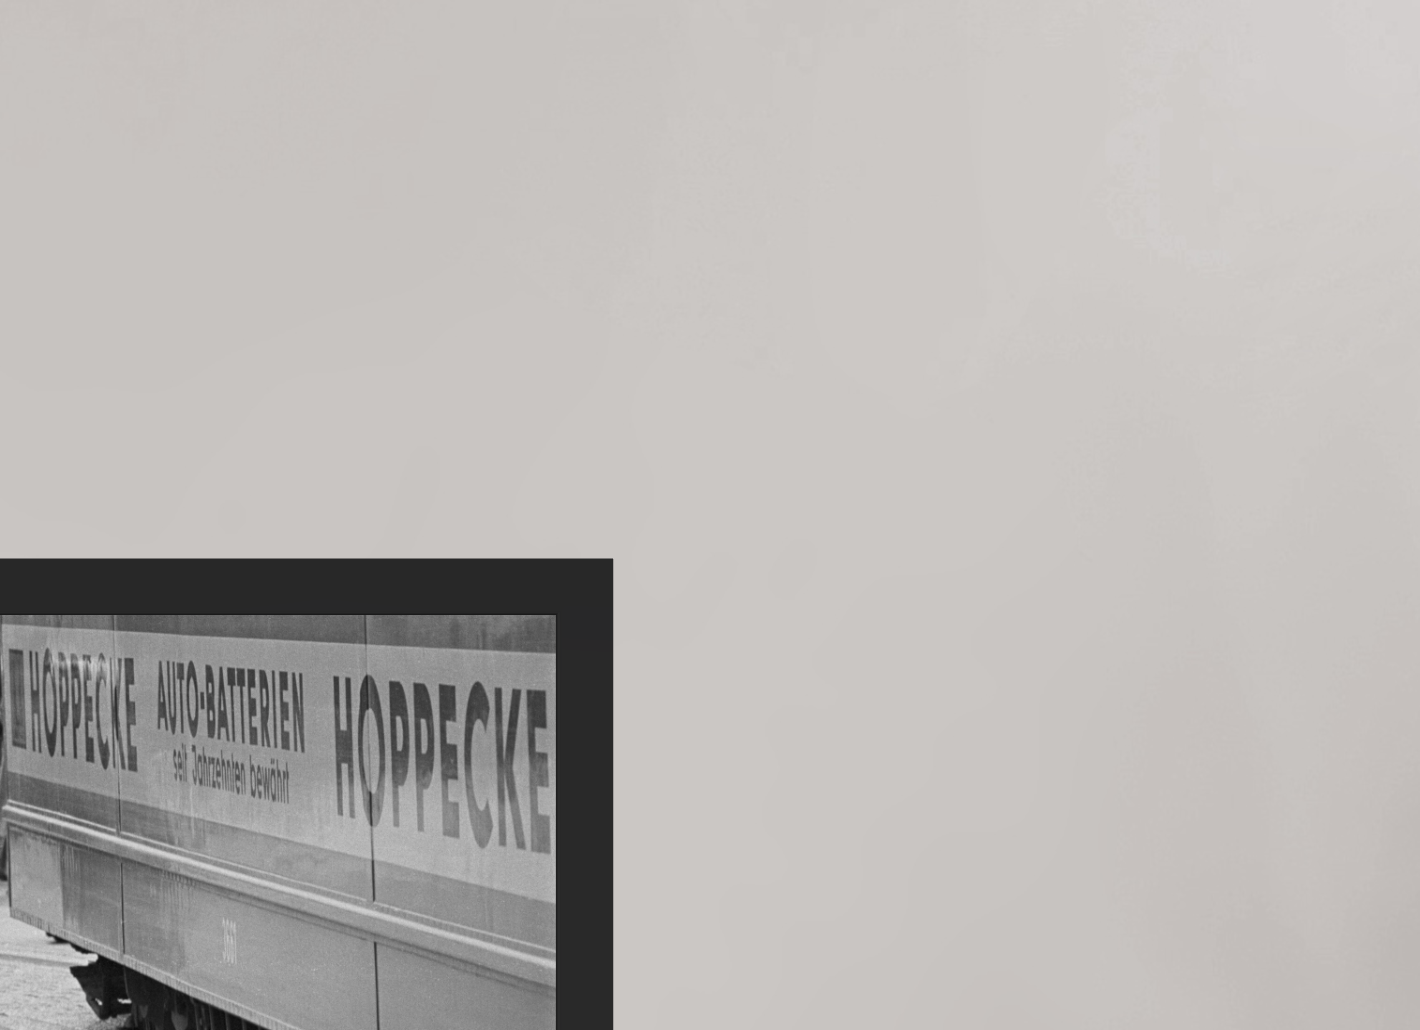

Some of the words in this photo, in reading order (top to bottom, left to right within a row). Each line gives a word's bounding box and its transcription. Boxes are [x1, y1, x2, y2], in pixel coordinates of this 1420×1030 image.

[29, 647, 138, 772] HOPPECKE
[157, 660, 305, 753] AUTO-BATTERIEN
[173, 742, 187, 783] seit
[191, 744, 246, 795] Jahrzehnten
[249, 754, 289, 804] bewährt
[333, 674, 552, 855] HOPPECKE
